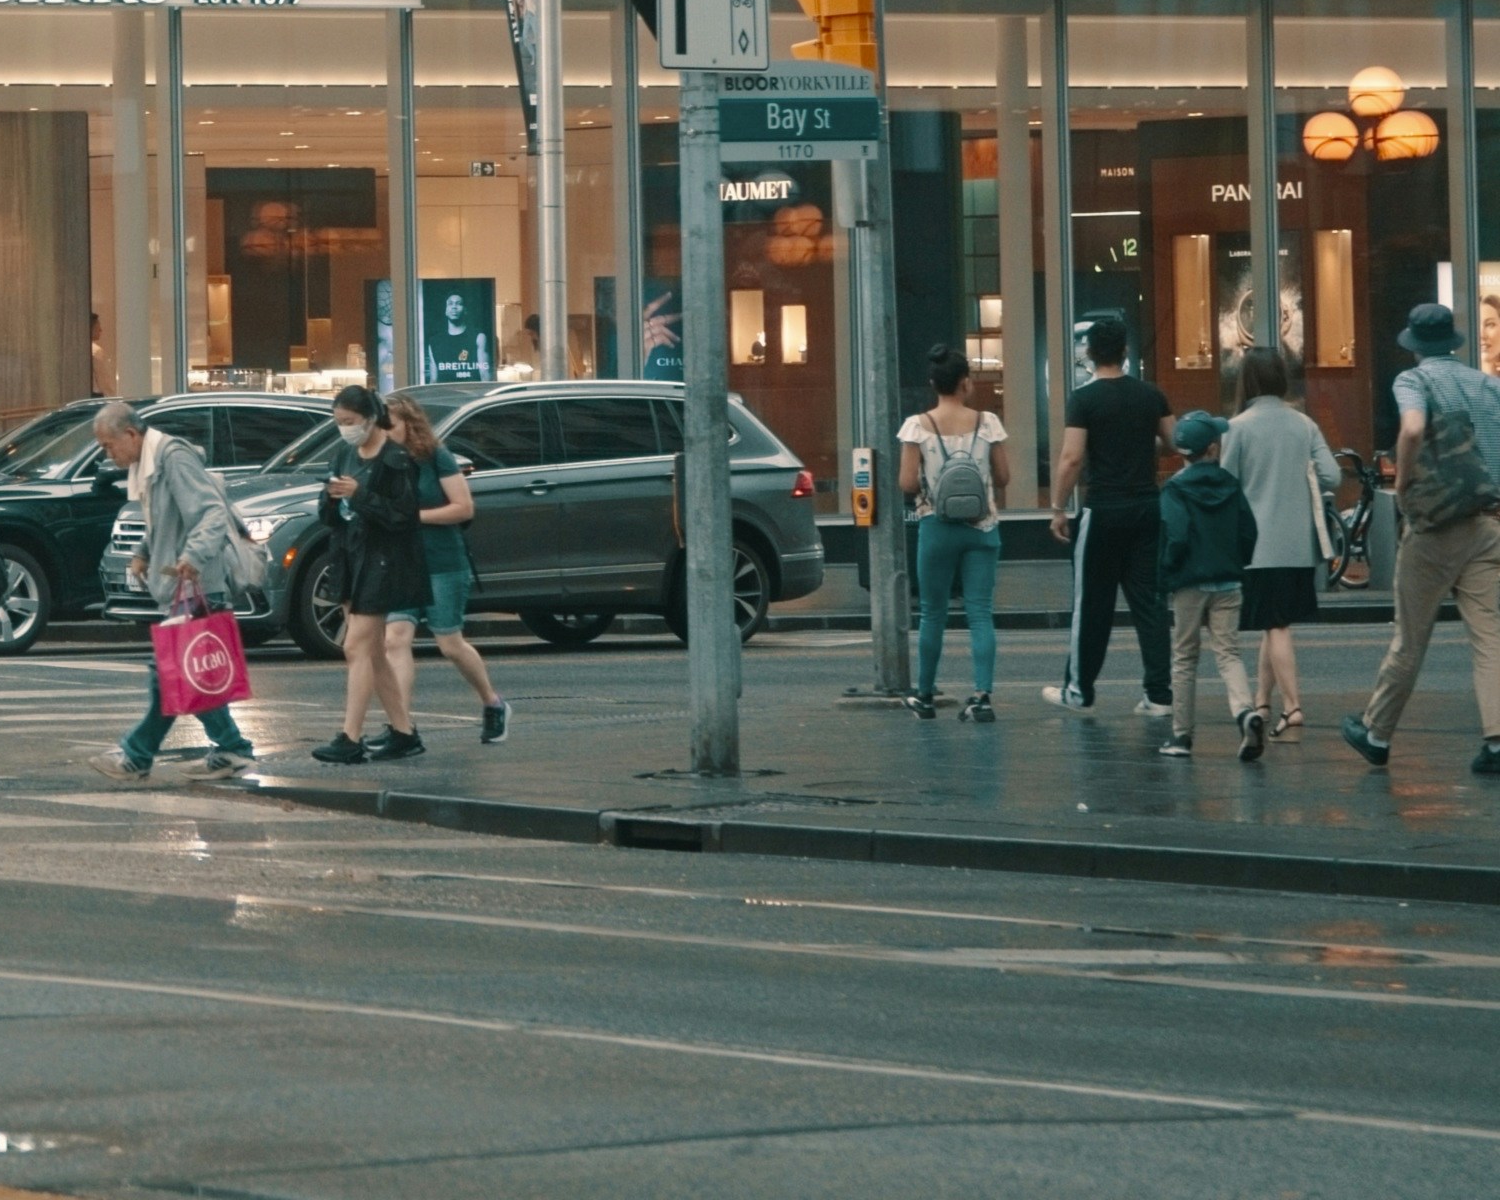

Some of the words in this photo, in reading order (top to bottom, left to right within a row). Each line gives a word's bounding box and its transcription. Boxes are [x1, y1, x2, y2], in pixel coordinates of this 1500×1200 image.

[767, 103, 807, 136] Bay
[814, 108, 831, 129] St
[778, 144, 814, 158] 1170
[1100, 167, 1135, 177] MAISON
[1211, 181, 1303, 202] PANAI
[438, 362, 490, 371] BREITLING
[192, 650, 228, 673] LCBO
